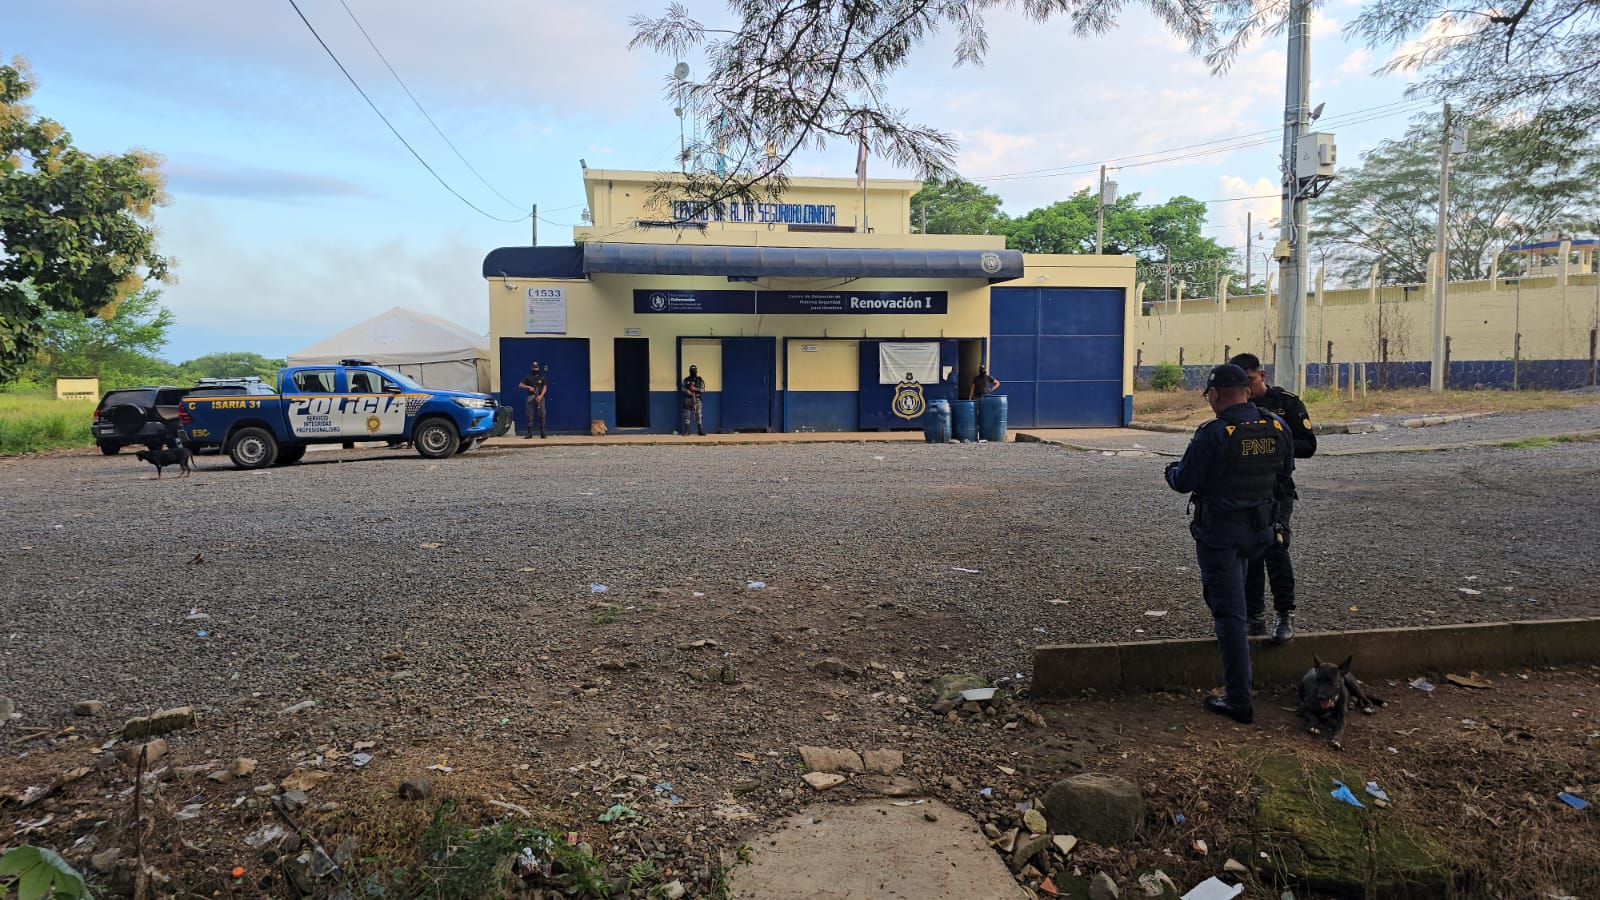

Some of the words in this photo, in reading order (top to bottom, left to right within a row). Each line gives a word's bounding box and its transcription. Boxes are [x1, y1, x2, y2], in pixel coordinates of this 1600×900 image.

[673, 200, 709, 221] CENO
[534, 289, 561, 297] 1533
[850, 296, 922, 309] Renovación
[925, 297, 932, 309] I
[249, 400, 261, 409] 31
[1241, 438, 1276, 456] PNC
